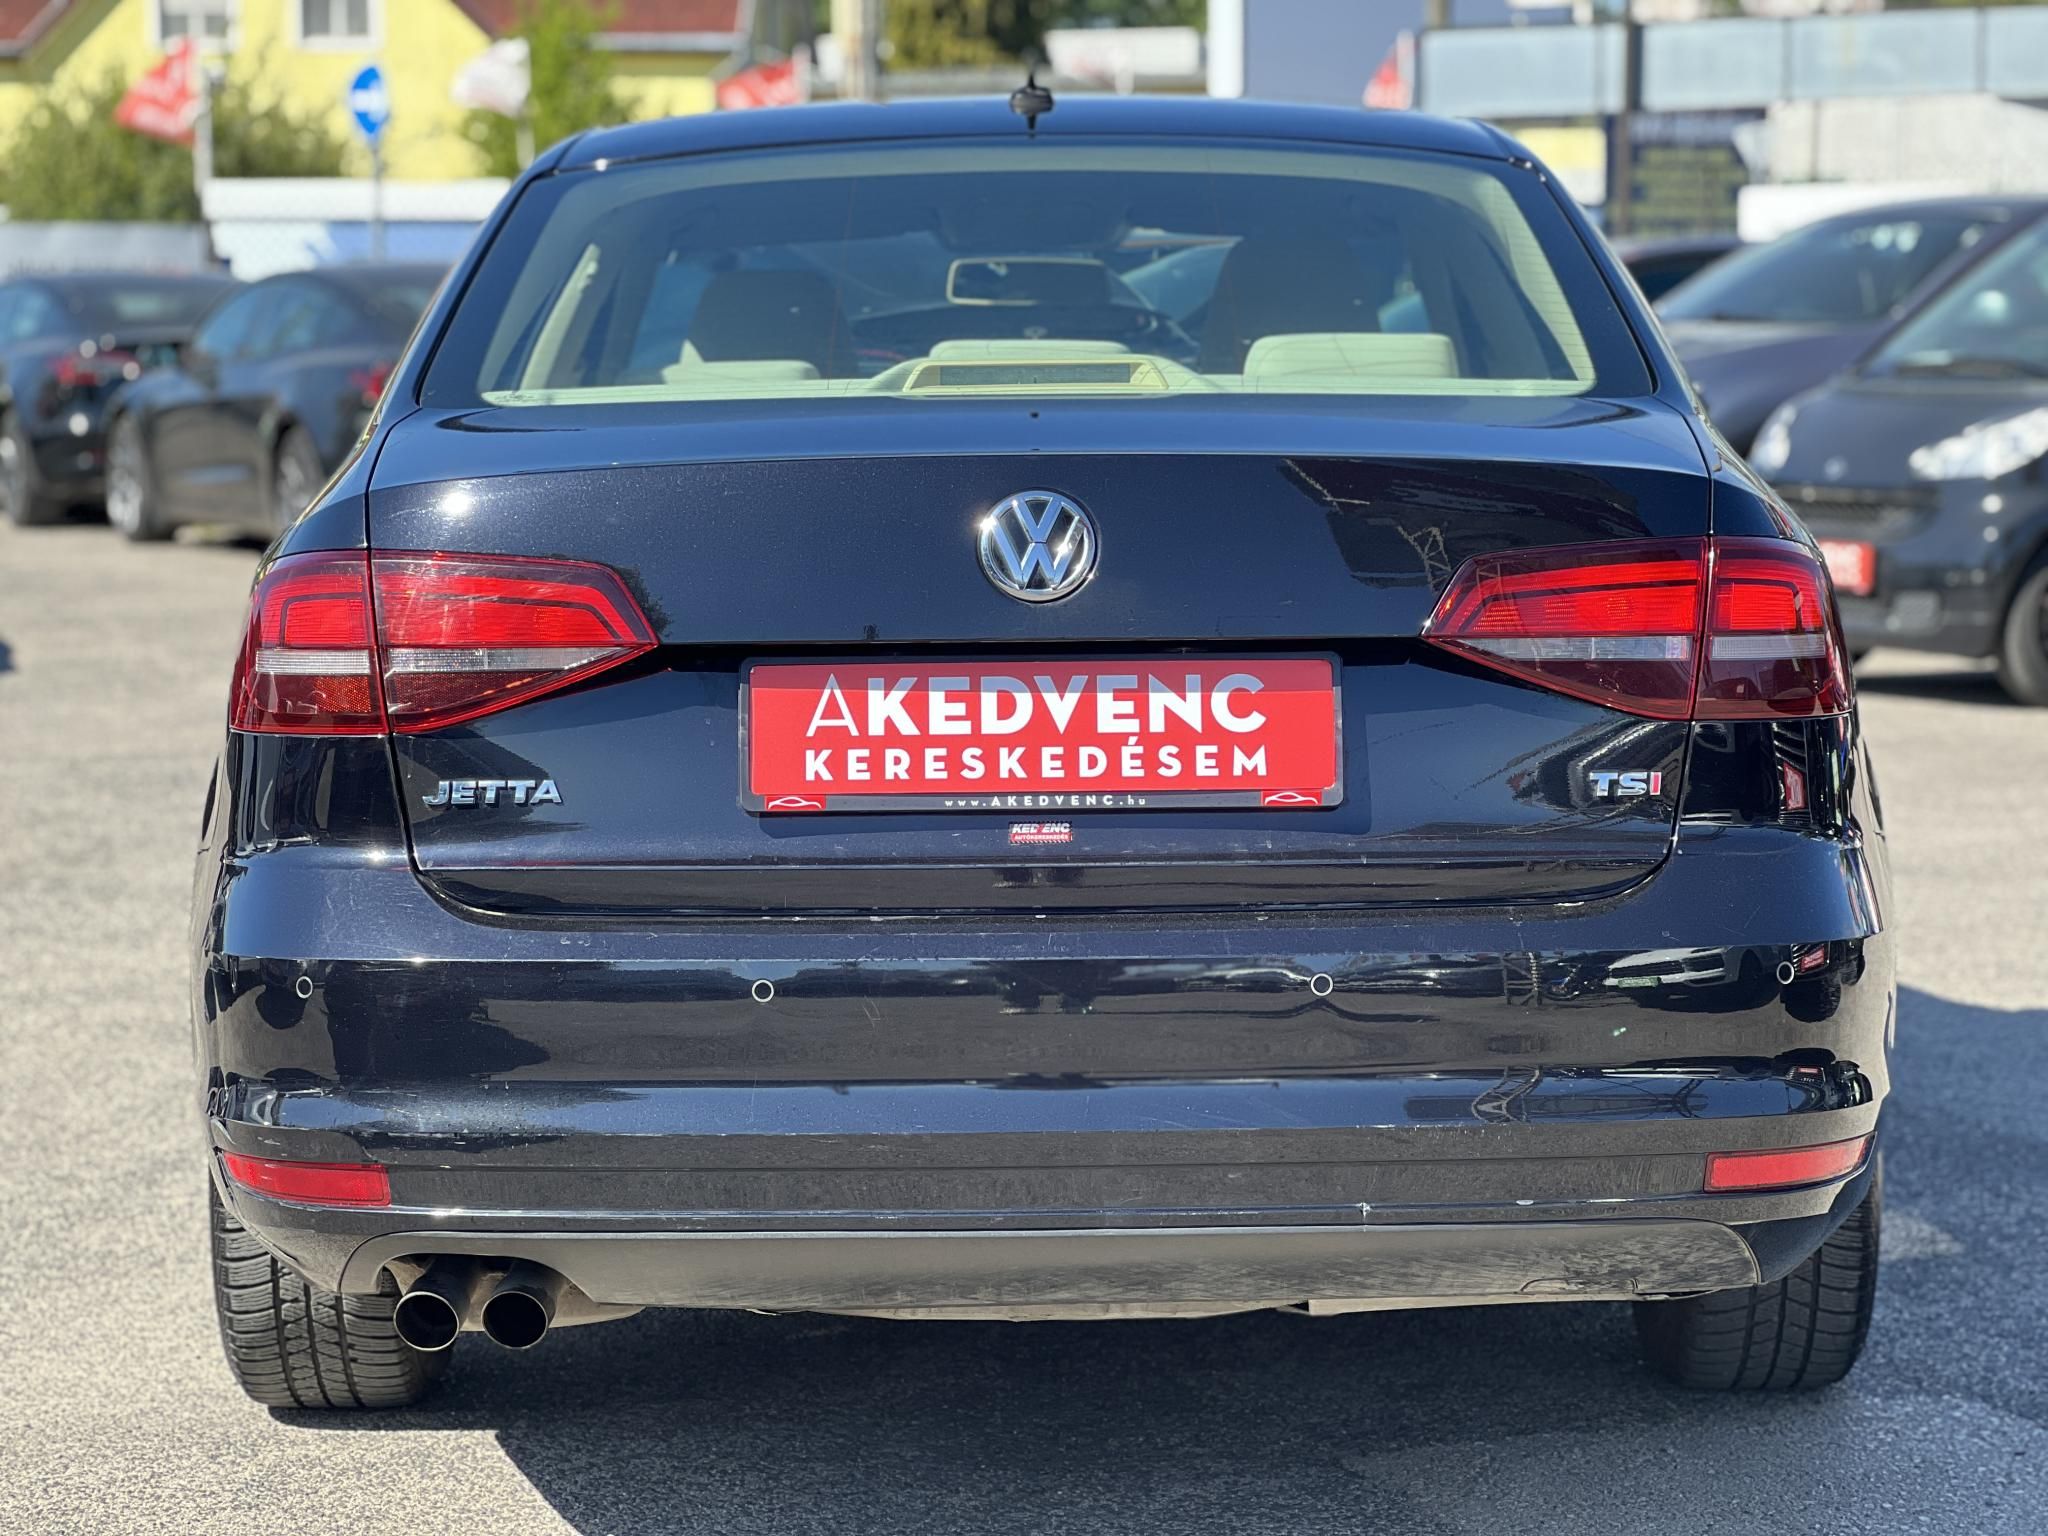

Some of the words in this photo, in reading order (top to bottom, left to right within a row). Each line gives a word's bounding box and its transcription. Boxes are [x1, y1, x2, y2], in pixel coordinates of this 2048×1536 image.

[805, 736, 1268, 781] KERESKEDÉSEM
[422, 779, 562, 805] JETTA
[1589, 771, 1662, 796] TSI
[944, 794, 1146, 807] www.AKEDVENC.hu
